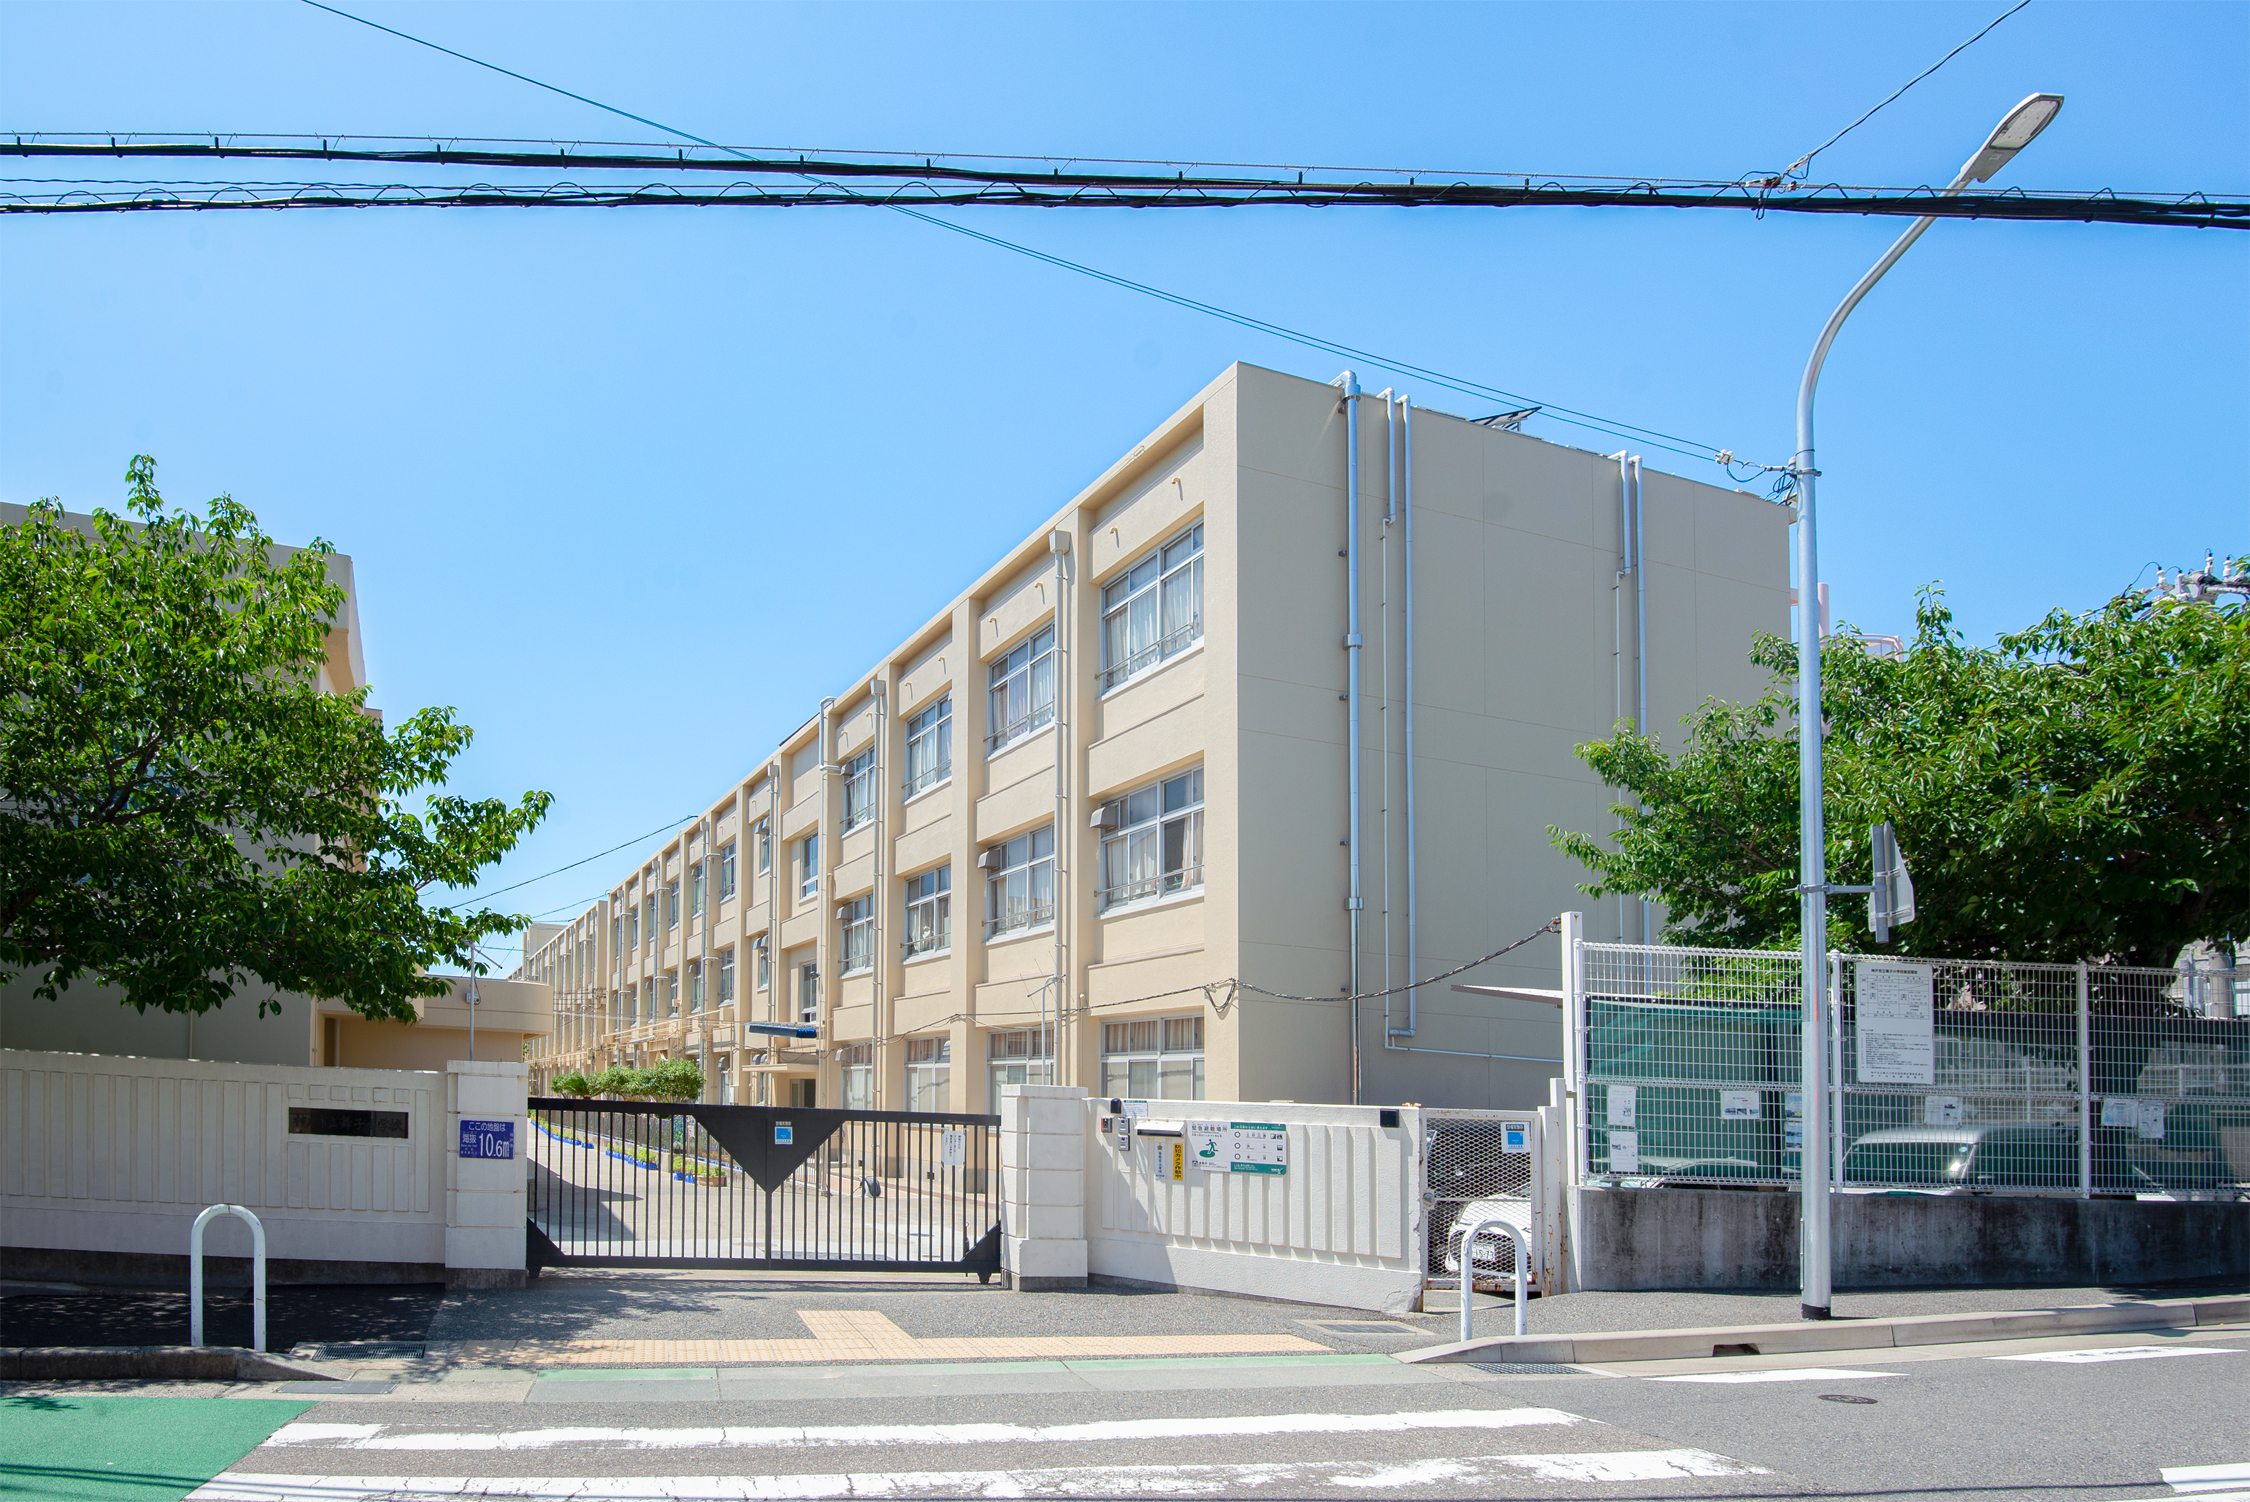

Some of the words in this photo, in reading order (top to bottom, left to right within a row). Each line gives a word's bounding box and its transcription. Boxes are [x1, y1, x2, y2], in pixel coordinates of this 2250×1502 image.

[468, 1122, 506, 1132] ここの地盤は
[479, 1132, 510, 1158] 10.6m
